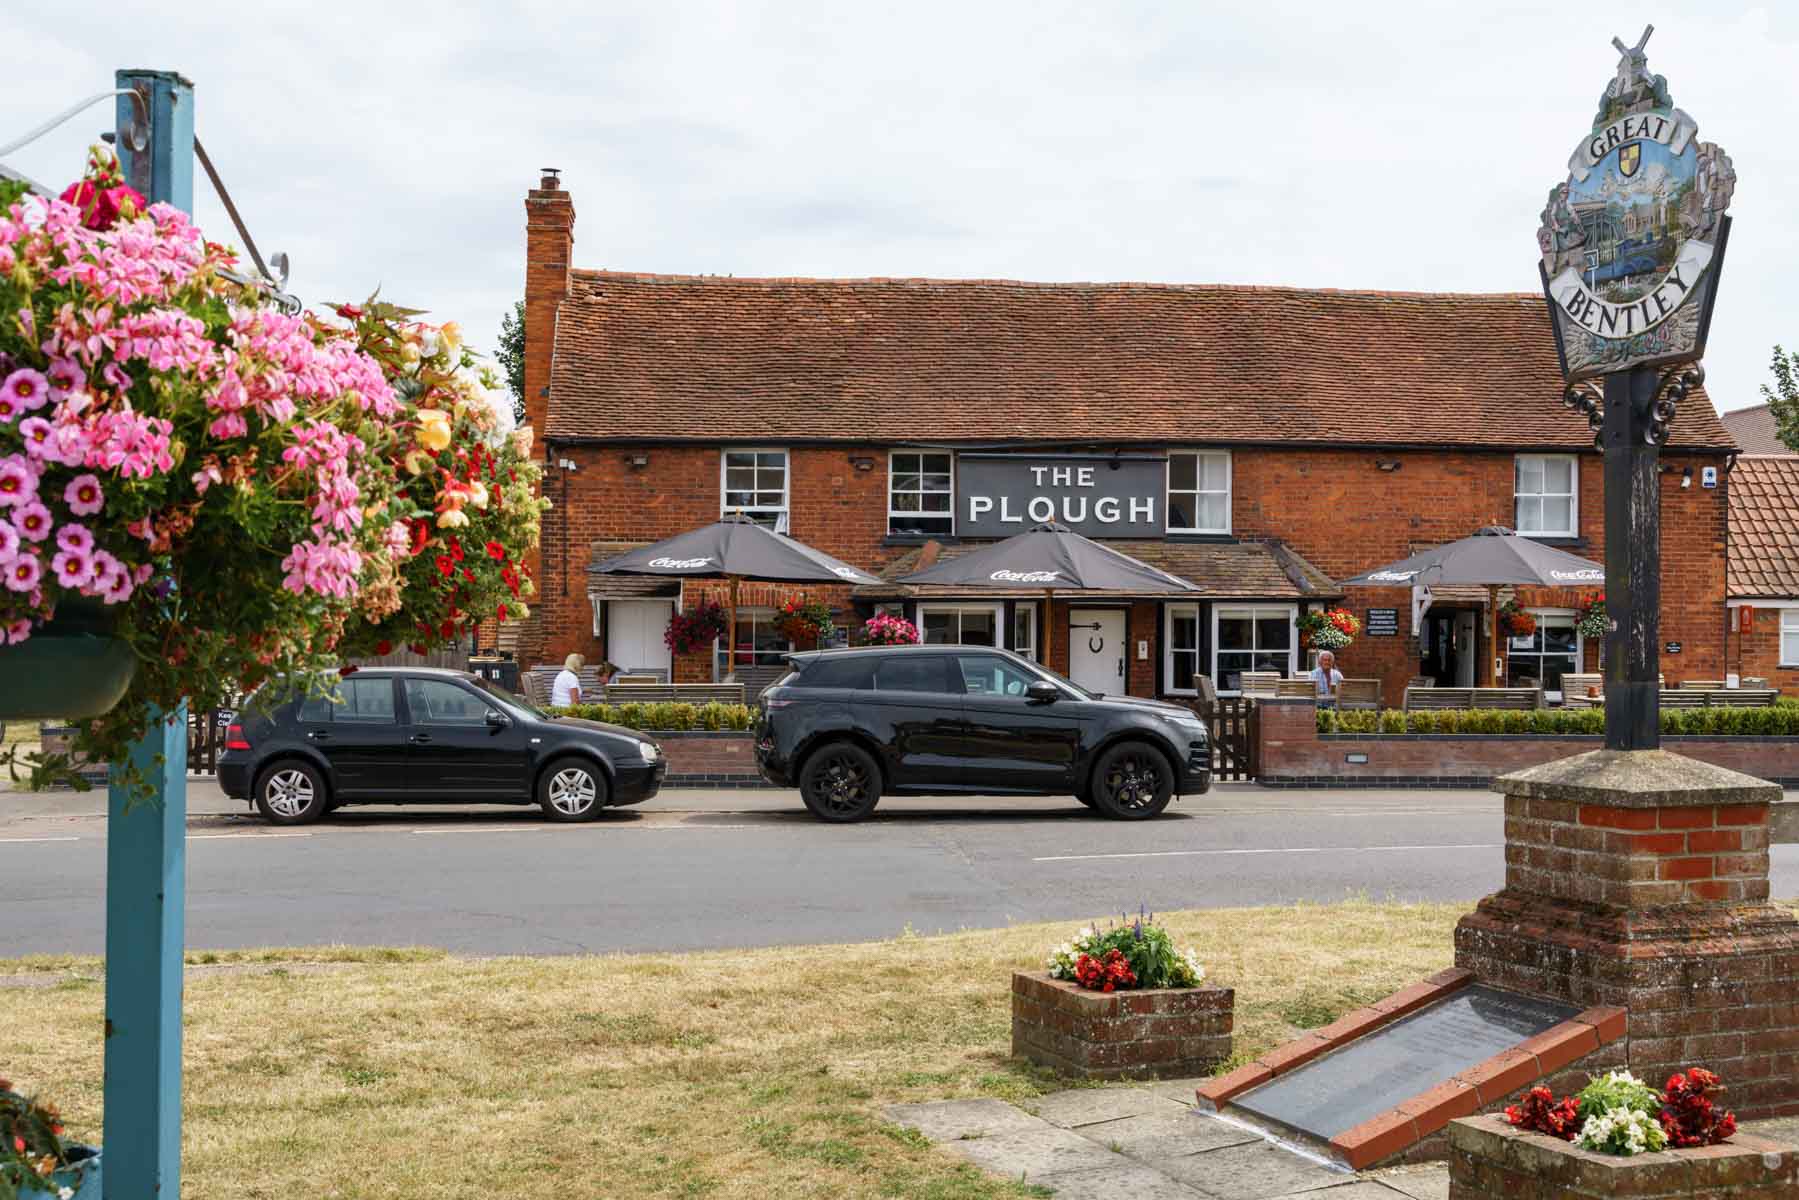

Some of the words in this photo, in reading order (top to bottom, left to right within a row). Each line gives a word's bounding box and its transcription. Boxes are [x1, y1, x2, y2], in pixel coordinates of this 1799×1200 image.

[1590, 116, 1668, 158] GREAT
[1566, 264, 1689, 334] BENTLEY
[1030, 466, 1095, 487] THE
[968, 496, 1155, 523] PLOUGH
